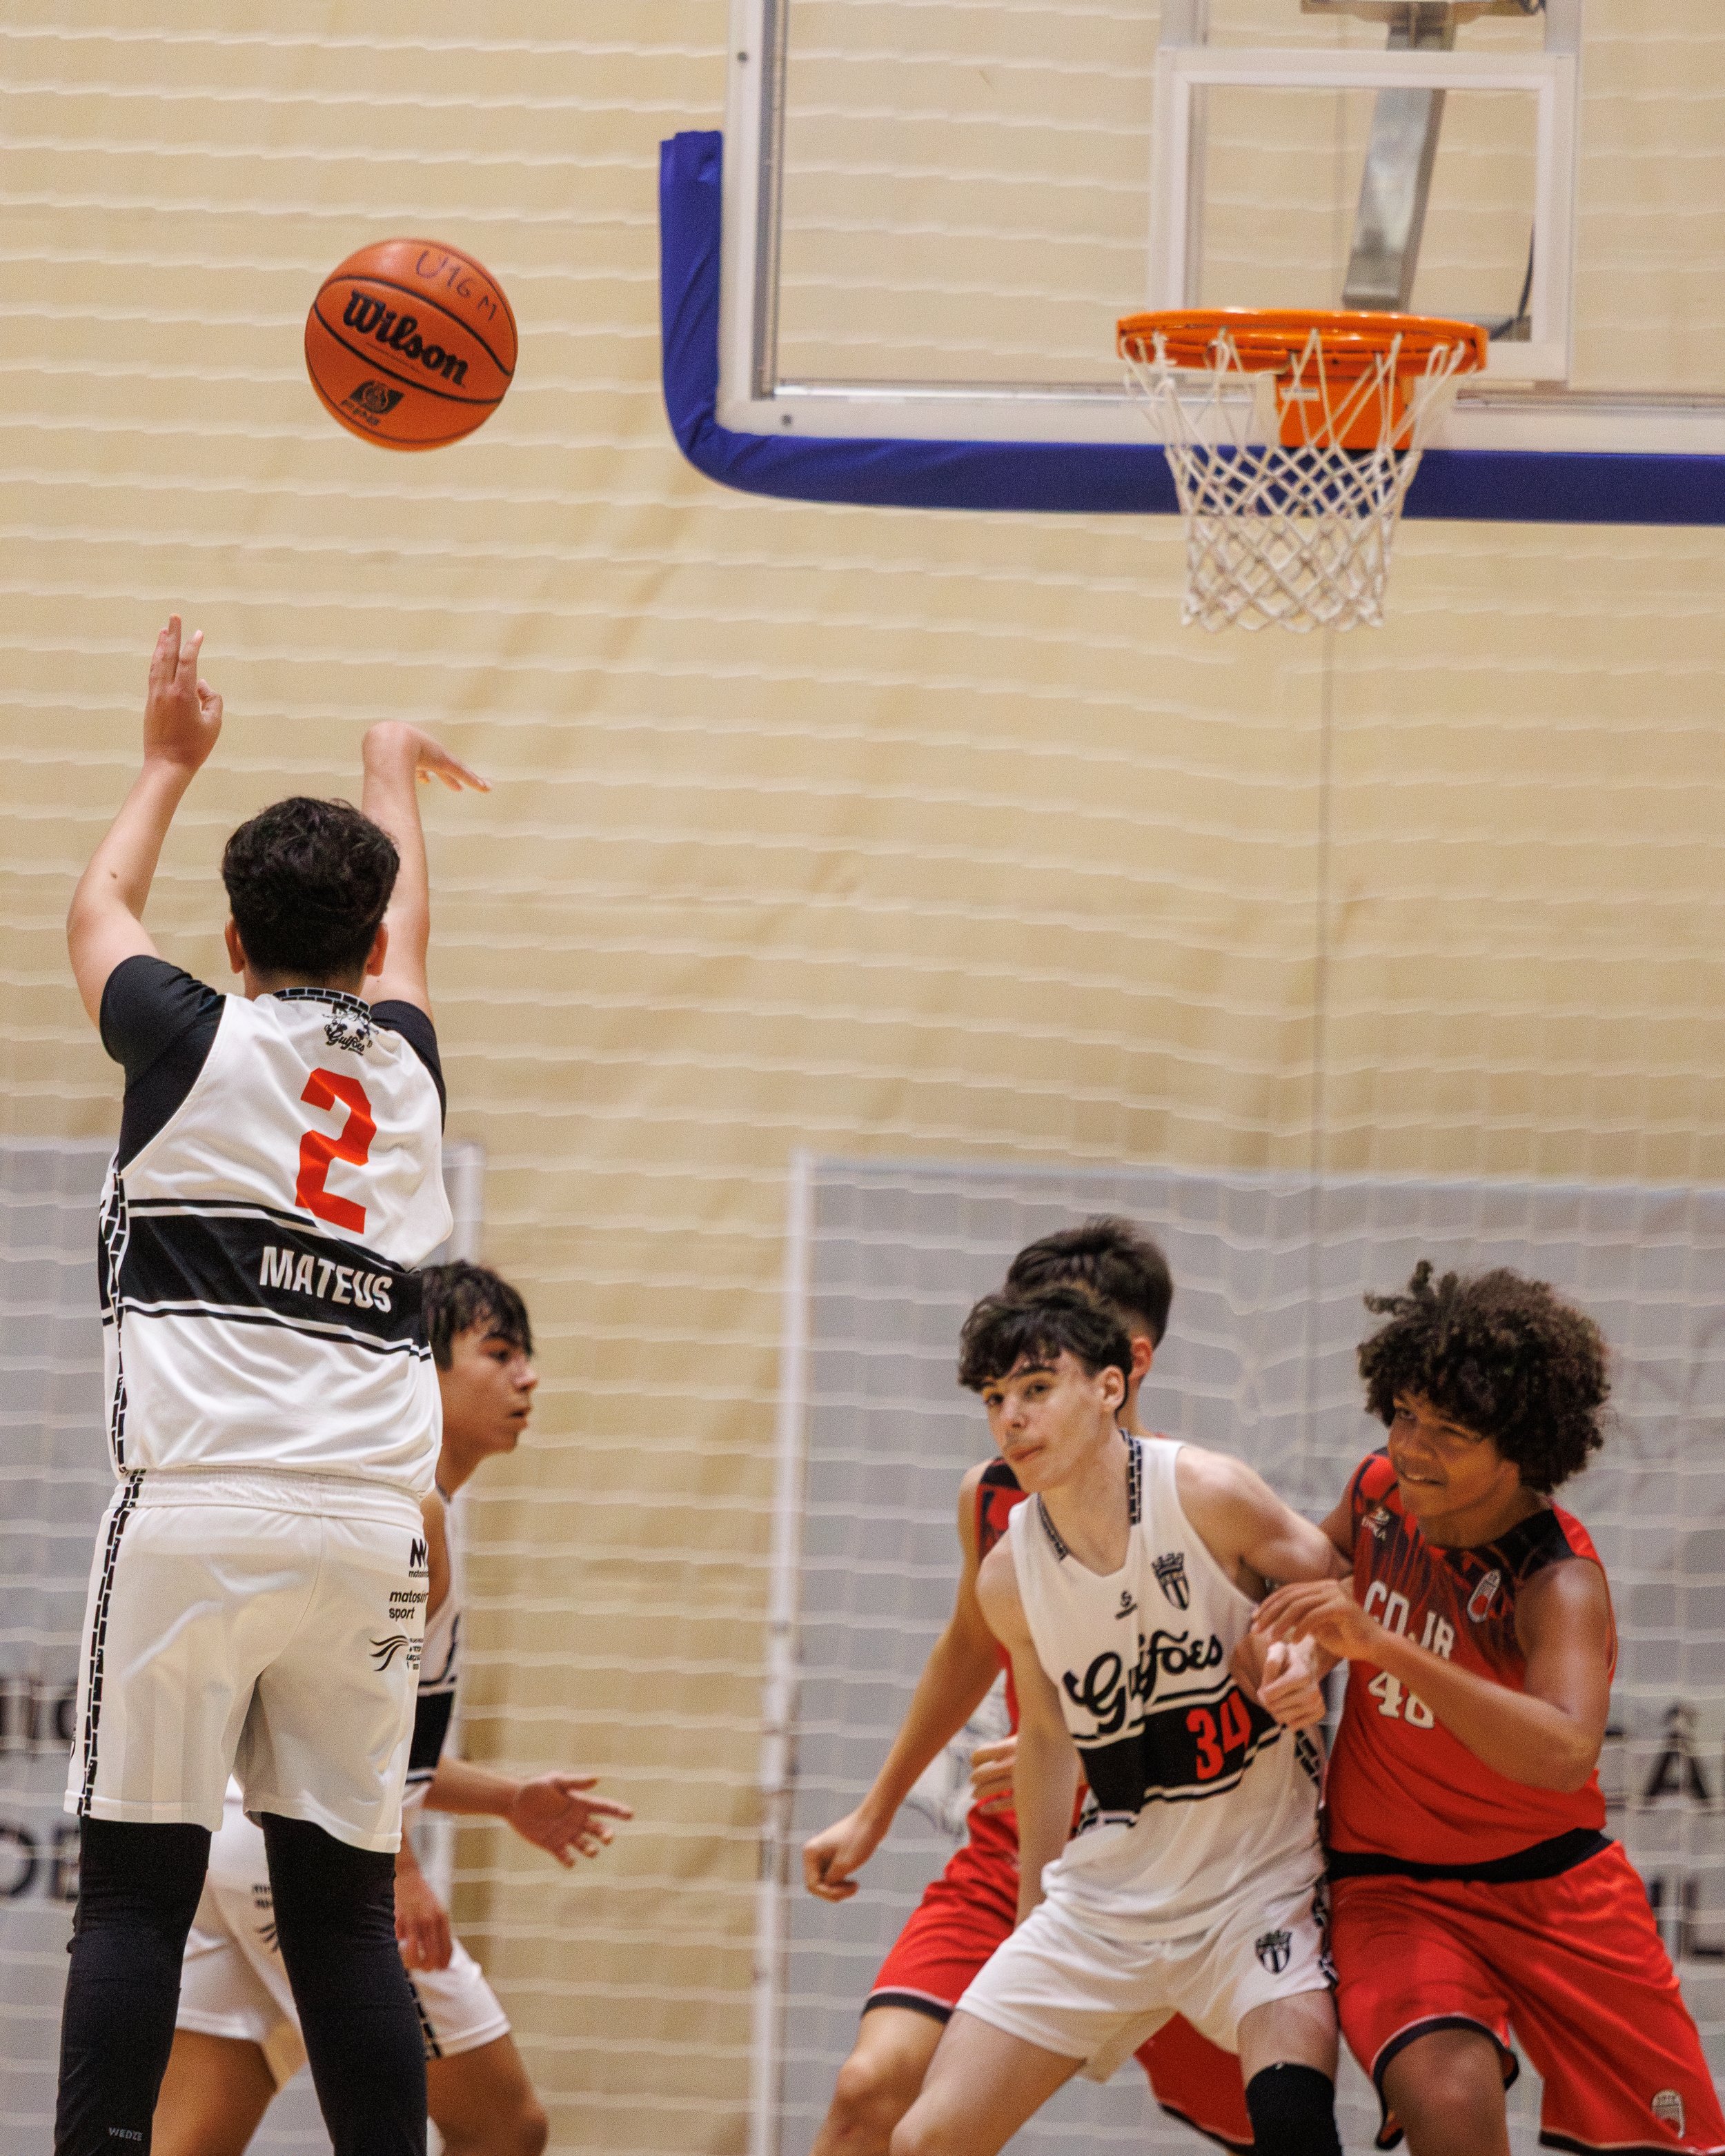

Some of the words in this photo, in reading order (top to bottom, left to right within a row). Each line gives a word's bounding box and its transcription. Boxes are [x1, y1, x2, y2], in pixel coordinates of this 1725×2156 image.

[415, 250, 473, 299] U16
[342, 288, 469, 388] Wilson
[295, 1067, 377, 1234] 2
[259, 1246, 392, 1313] MATEUS
[389, 1607, 415, 1621] sport
[1185, 1690, 1252, 1781] 34
